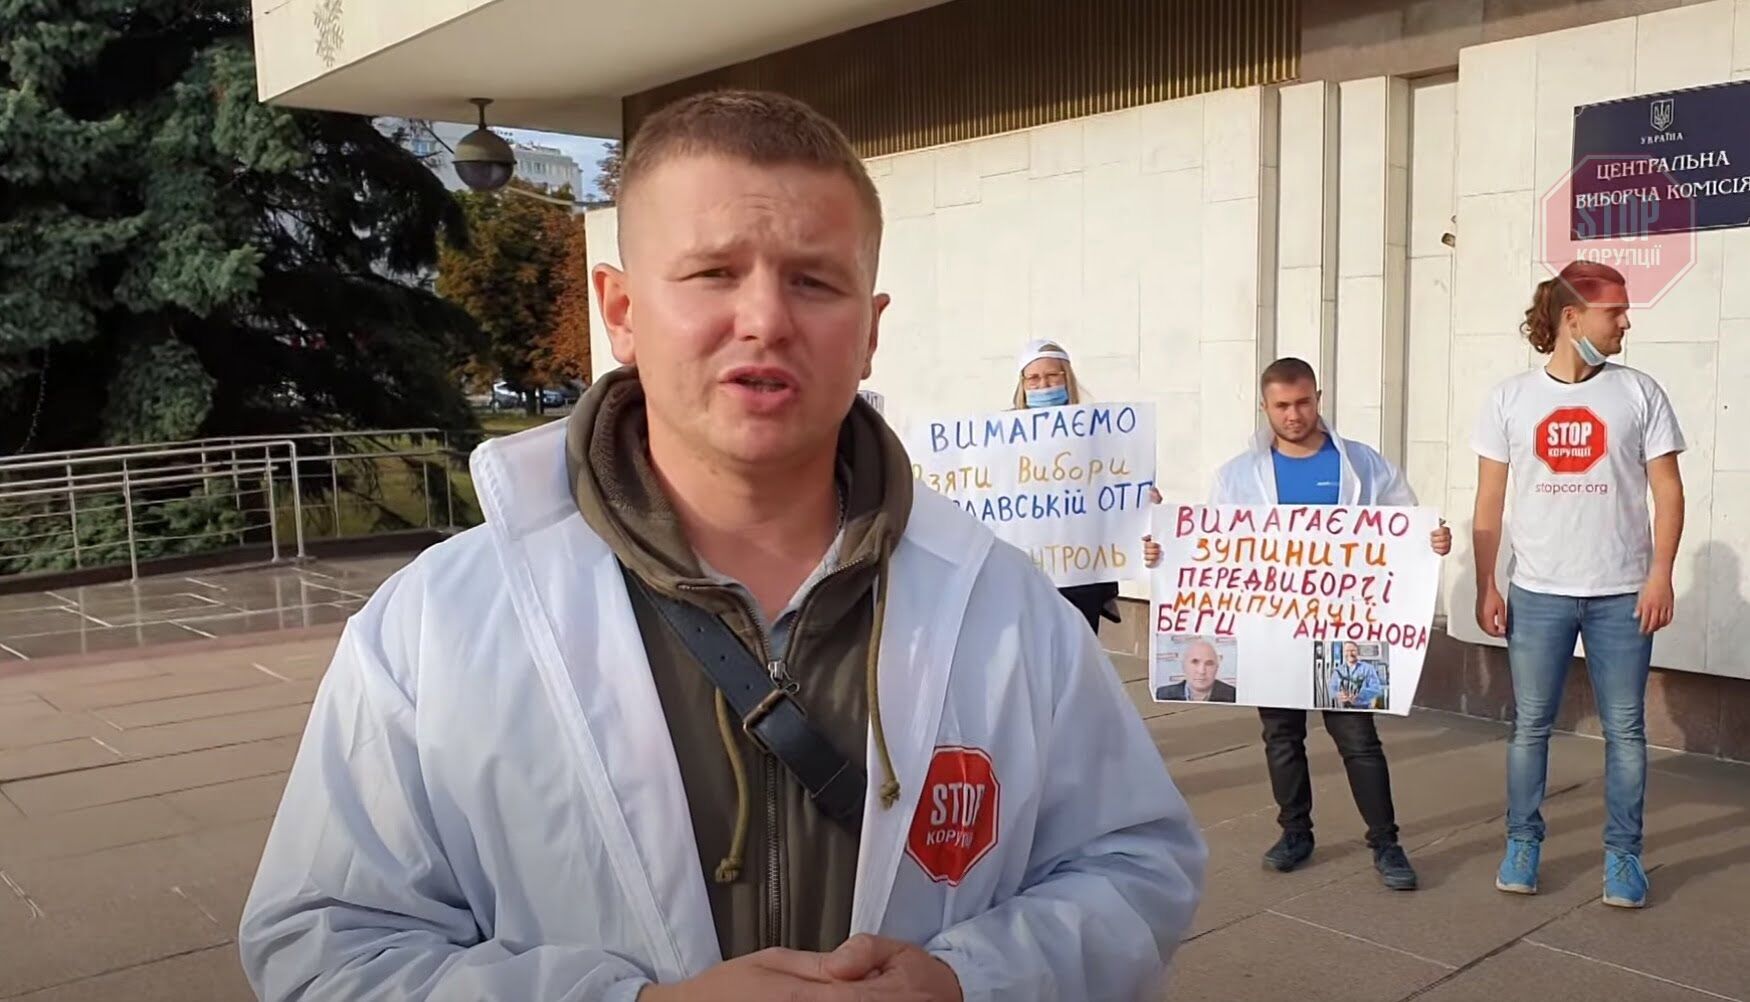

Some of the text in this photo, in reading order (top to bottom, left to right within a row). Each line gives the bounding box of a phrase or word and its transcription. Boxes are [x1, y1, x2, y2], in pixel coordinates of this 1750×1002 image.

[1640, 132, 1684, 145] УКРАЇНА
[1597, 150, 1731, 180] ЦЕНТРАЛЬНА
[1575, 176, 1750, 209] ВИБОРЧА КОМІСІЯ
[930, 406, 1136, 453] ВИМАГАЄМО
[1547, 421, 1593, 446] STOP
[1175, 505, 1410, 538] ВИМАГАЄМО
[1029, 543, 1127, 575] НТРОЛЬ
[1191, 537, 1388, 567] ЗУПИНИТИ
[1177, 566, 1395, 604] ПЕРЕДВИБОРЧІ
[1292, 619, 1427, 650] АНТОНОВА
